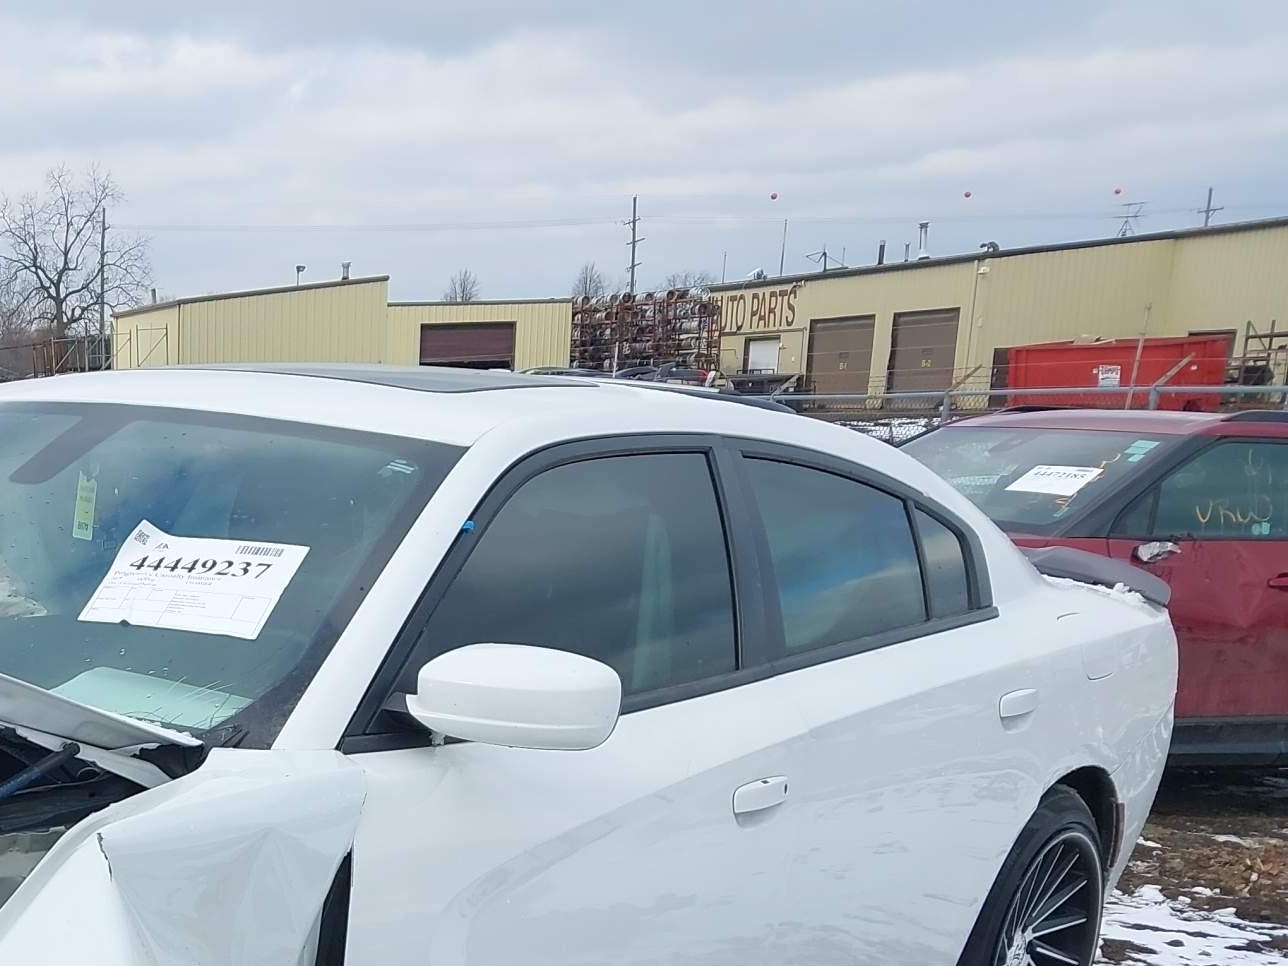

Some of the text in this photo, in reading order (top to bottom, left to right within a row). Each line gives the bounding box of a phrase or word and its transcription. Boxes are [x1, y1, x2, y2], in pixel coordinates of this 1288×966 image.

[712, 286, 798, 332] UTO PARTS
[129, 555, 273, 579] 44449237
